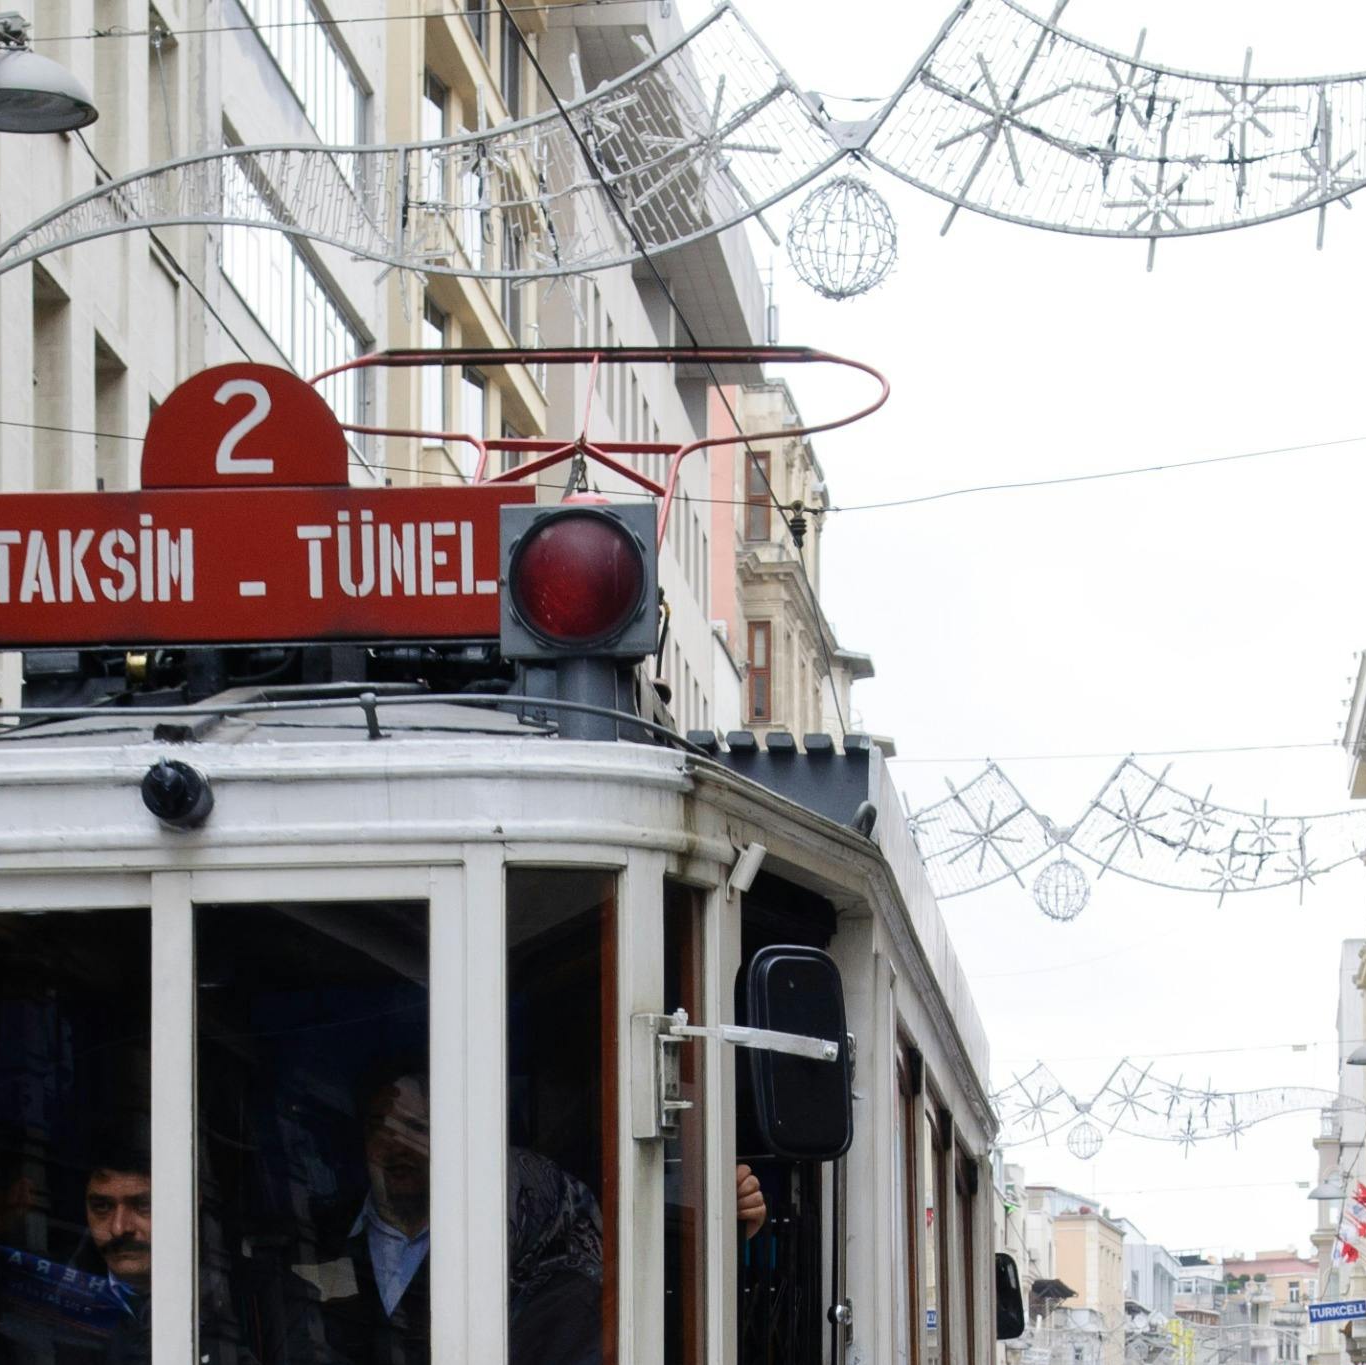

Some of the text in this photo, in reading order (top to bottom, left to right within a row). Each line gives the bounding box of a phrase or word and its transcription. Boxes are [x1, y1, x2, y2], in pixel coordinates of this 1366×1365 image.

[213, 378, 274, 475] 2
[296, 509, 498, 599] TÜNEL
[1310, 1303, 1366, 1321] TURKCELL
